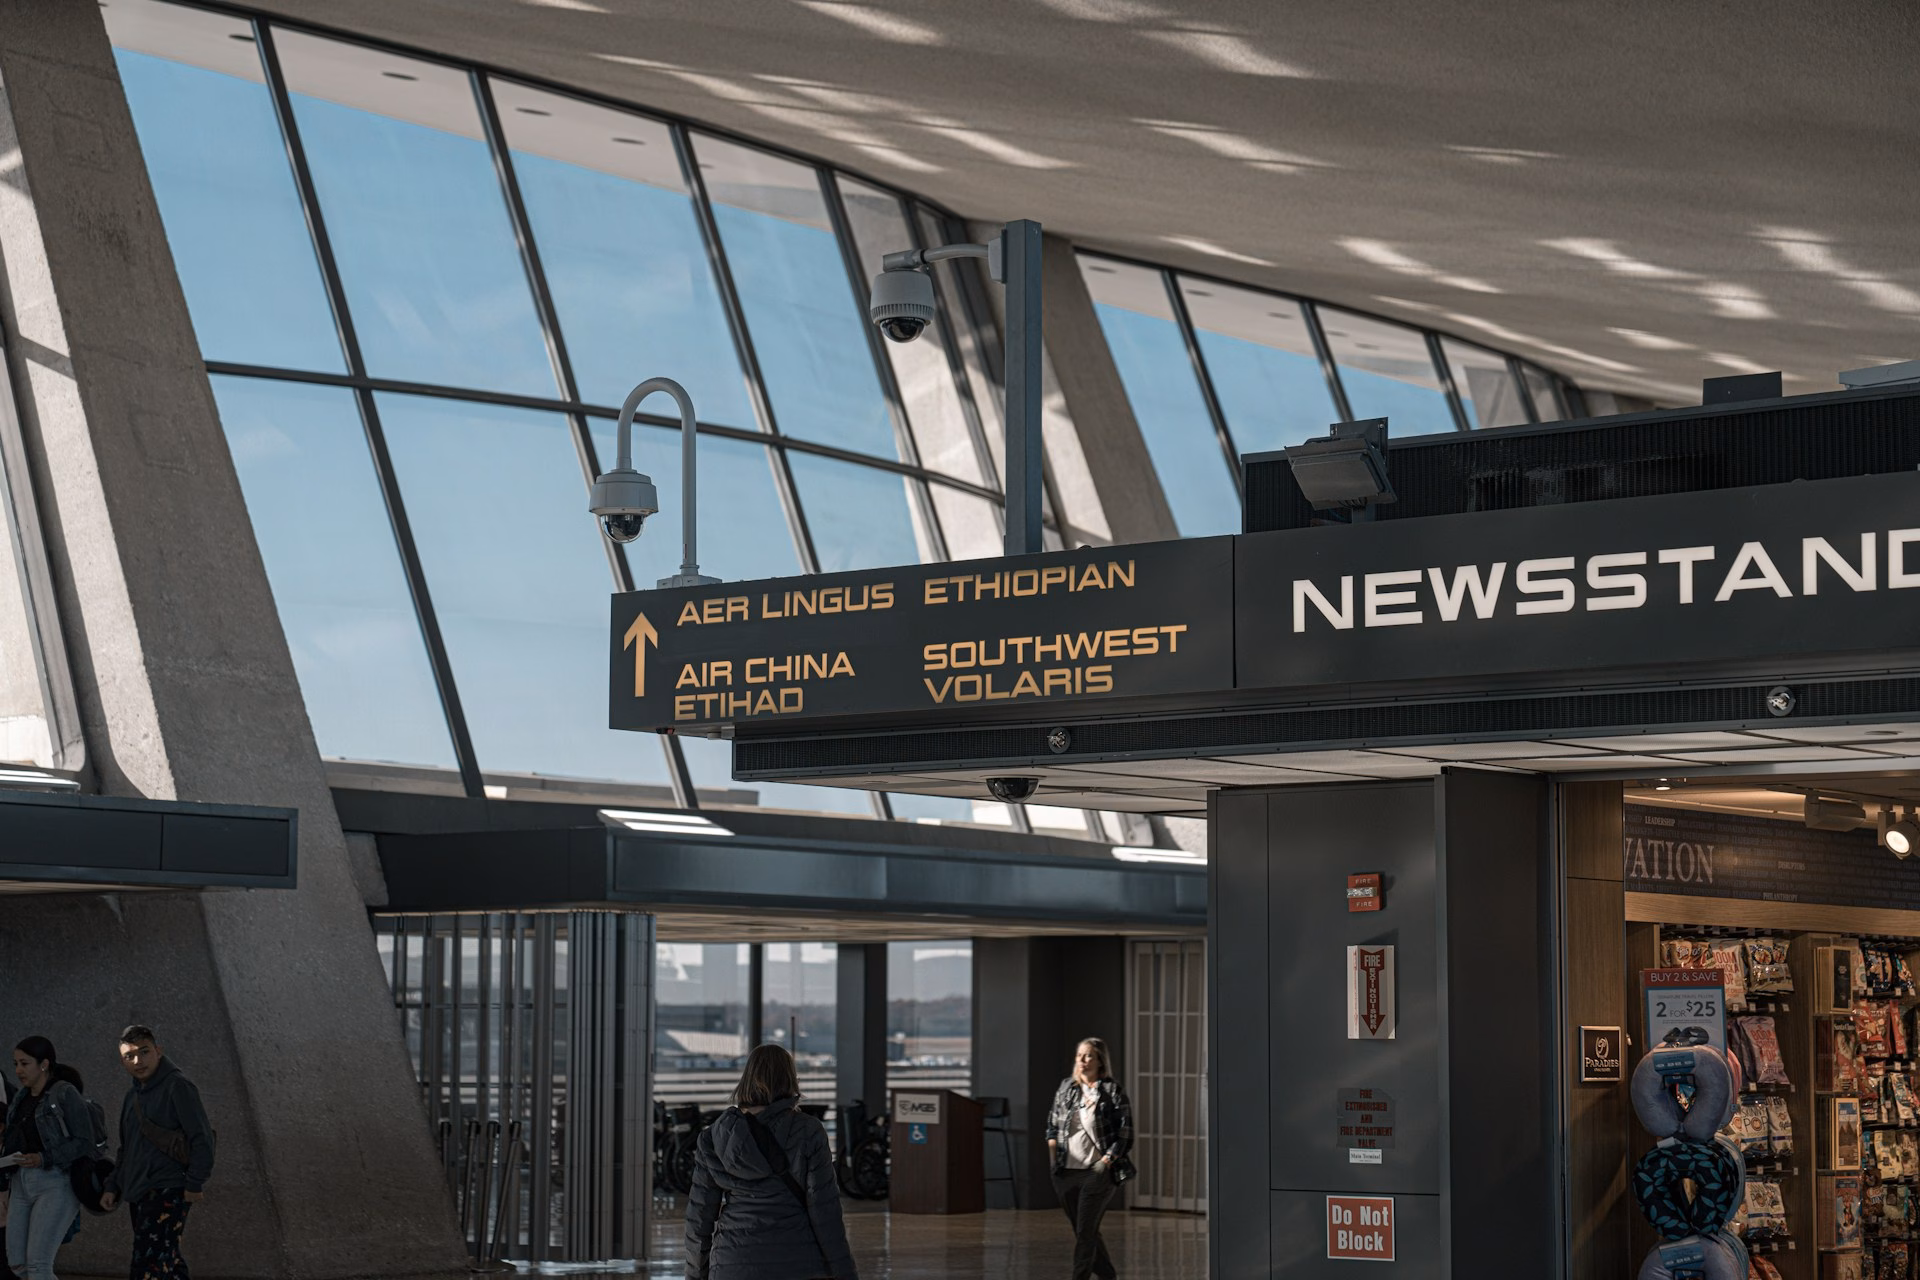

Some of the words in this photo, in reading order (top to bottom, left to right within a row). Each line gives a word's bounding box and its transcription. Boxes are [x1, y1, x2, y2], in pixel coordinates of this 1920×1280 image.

[923, 560, 1136, 605] ETHIOPIAN
[676, 596, 750, 626] AER
[761, 583, 894, 619] LINGUS
[923, 624, 1188, 671] SOUTHWEST
[675, 660, 732, 689] AIR
[745, 652, 856, 684] CHINA
[923, 664, 1113, 704] VOLARIS
[674, 687, 804, 721] ETIHAD
[1644, 815, 1676, 827] LEADERSHIP
[1364, 954, 1381, 967] FIRE
[1650, 972, 1672, 982] BUY
[1674, 972, 1680, 982] 2
[1682, 972, 1690, 982] &
[1692, 971, 1718, 982] SAVE
[1369, 967, 1378, 1029] EXTINGUISHER
[1656, 1001, 1667, 1017] 2
[1669, 1009, 1687, 1018] FOR
[1687, 1000, 1716, 1017] $25
[1585, 1056, 1619, 1068] PARADIES
[1359, 1089, 1372, 1098] FIRE
[1340, 1126, 1354, 1136] FIRE
[1355, 1126, 1393, 1137] DEPARTMENT
[1332, 1204, 1353, 1225] Do
[1360, 1205, 1389, 1227] Not
[1337, 1230, 1384, 1252] Block
